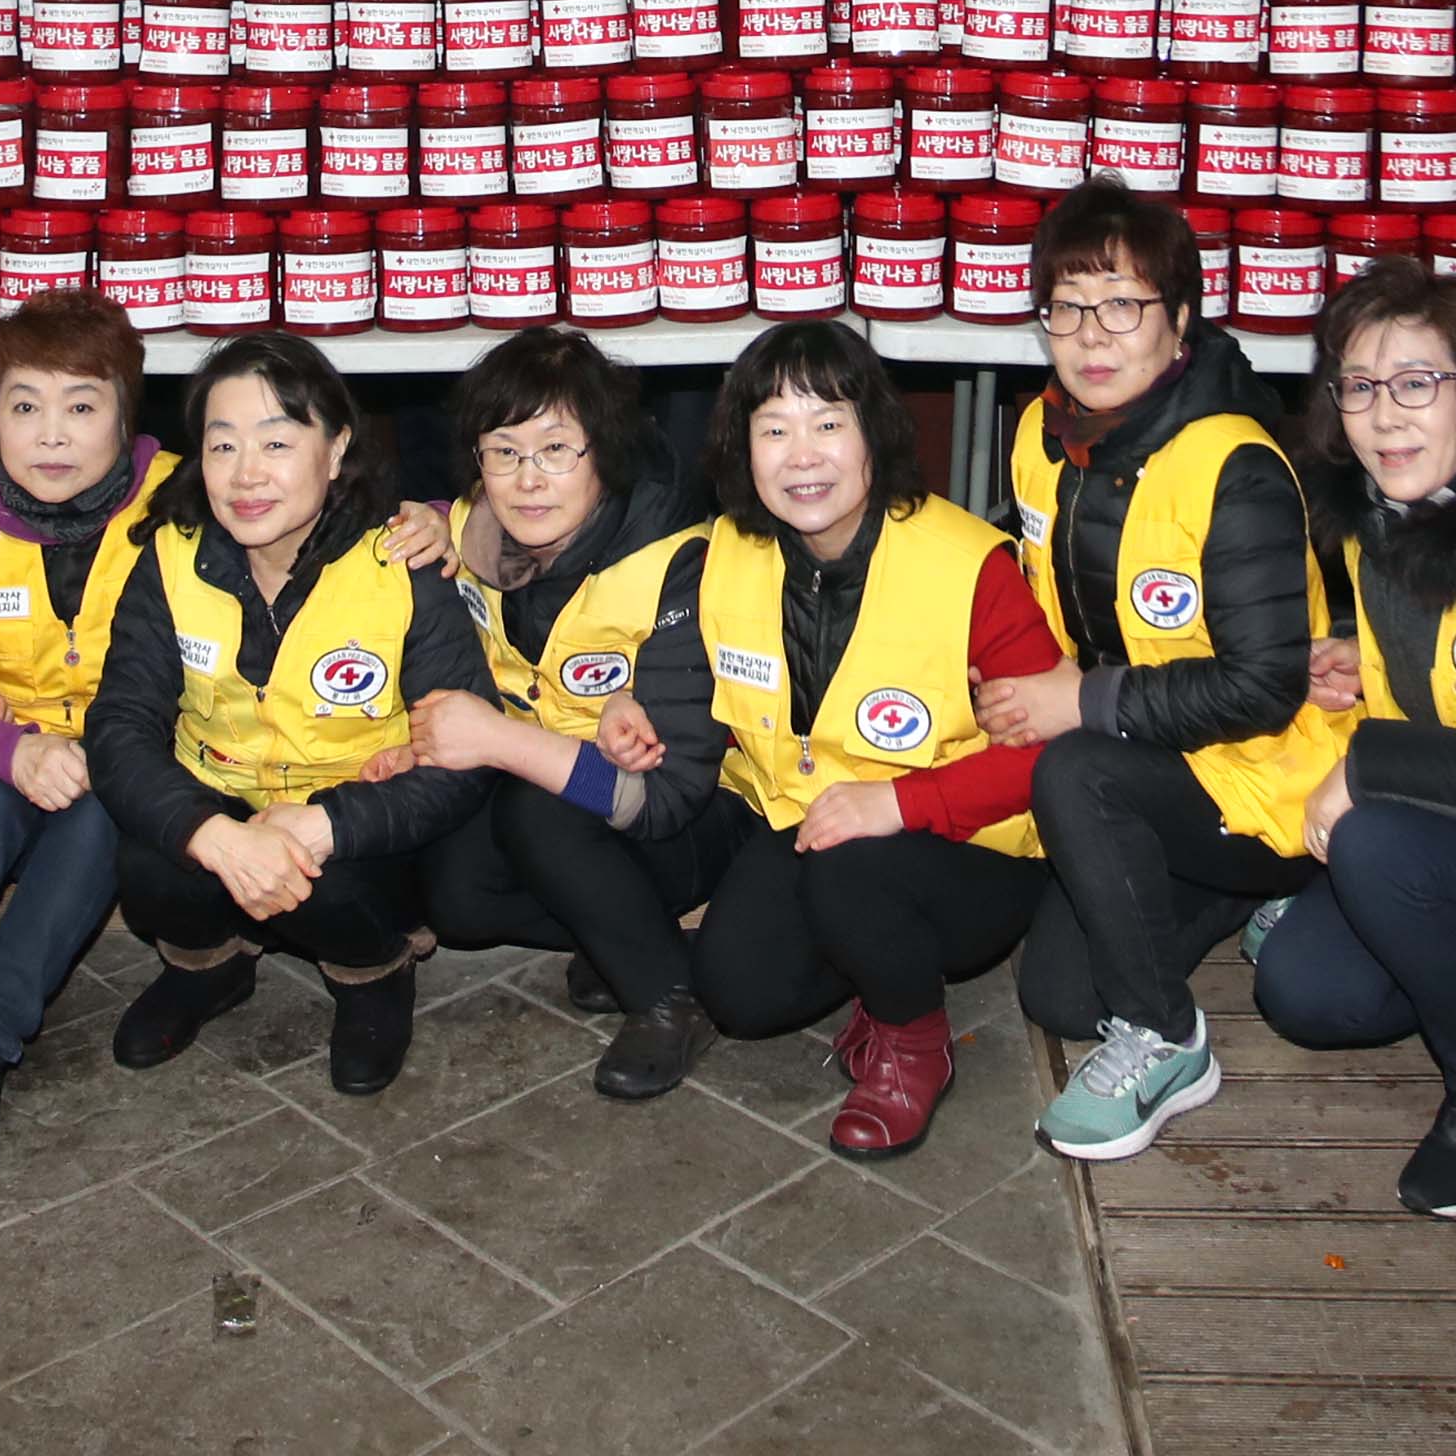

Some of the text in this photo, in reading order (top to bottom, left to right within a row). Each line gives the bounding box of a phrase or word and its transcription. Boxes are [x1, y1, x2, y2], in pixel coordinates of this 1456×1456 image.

[638, 12, 690, 30] 사랑나눔
[743, 15, 795, 32] 사랑나눔
[856, 11, 908, 29] 사랑나눔
[967, 16, 1018, 36] 사랑나눔
[1071, 15, 1122, 33] 사랑나눔
[1176, 18, 1229, 37] 사랑나눔
[35, 26, 87, 45] 사랑나눔
[147, 27, 201, 46] 사랑나눔
[250, 31, 302, 49] 사랑나눔
[353, 27, 406, 44] 사랑나눔
[451, 28, 503, 44] 사랑나눔
[548, 24, 601, 41] 사랑나눔
[1274, 30, 1329, 47] 사랑나눔
[1369, 32, 1424, 50] 사랑나눔
[811, 137, 868, 153] 사랑나눔
[918, 136, 973, 153] 사랑나눔
[1002, 143, 1056, 164] 사랑나눔
[325, 154, 376, 172] 사랑나눔
[423, 154, 476, 172] 사랑나눔
[517, 149, 567, 167] 사랑나눔
[612, 145, 661, 163] 사랑나눔
[715, 147, 771, 164] 사랑나눔
[1097, 147, 1150, 164] 사랑나눔
[1205, 152, 1263, 169] 사랑나눔
[1283, 156, 1334, 174] 사랑나눔
[1387, 158, 1446, 176] 사랑나눔
[473, 273, 523, 289] 사랑나눔
[576, 272, 633, 290] 사랑나눔
[664, 266, 716, 283] 사랑나눔
[759, 266, 814, 284] 사랑나눔
[860, 266, 915, 284] 사랑나눔
[960, 269, 1018, 288] 사랑나눔
[1244, 273, 1302, 291] 사랑나눔
[105, 285, 160, 303] 사랑나눔
[290, 279, 347, 297] 사랑나눔
[389, 276, 444, 294] 사랑나눔
